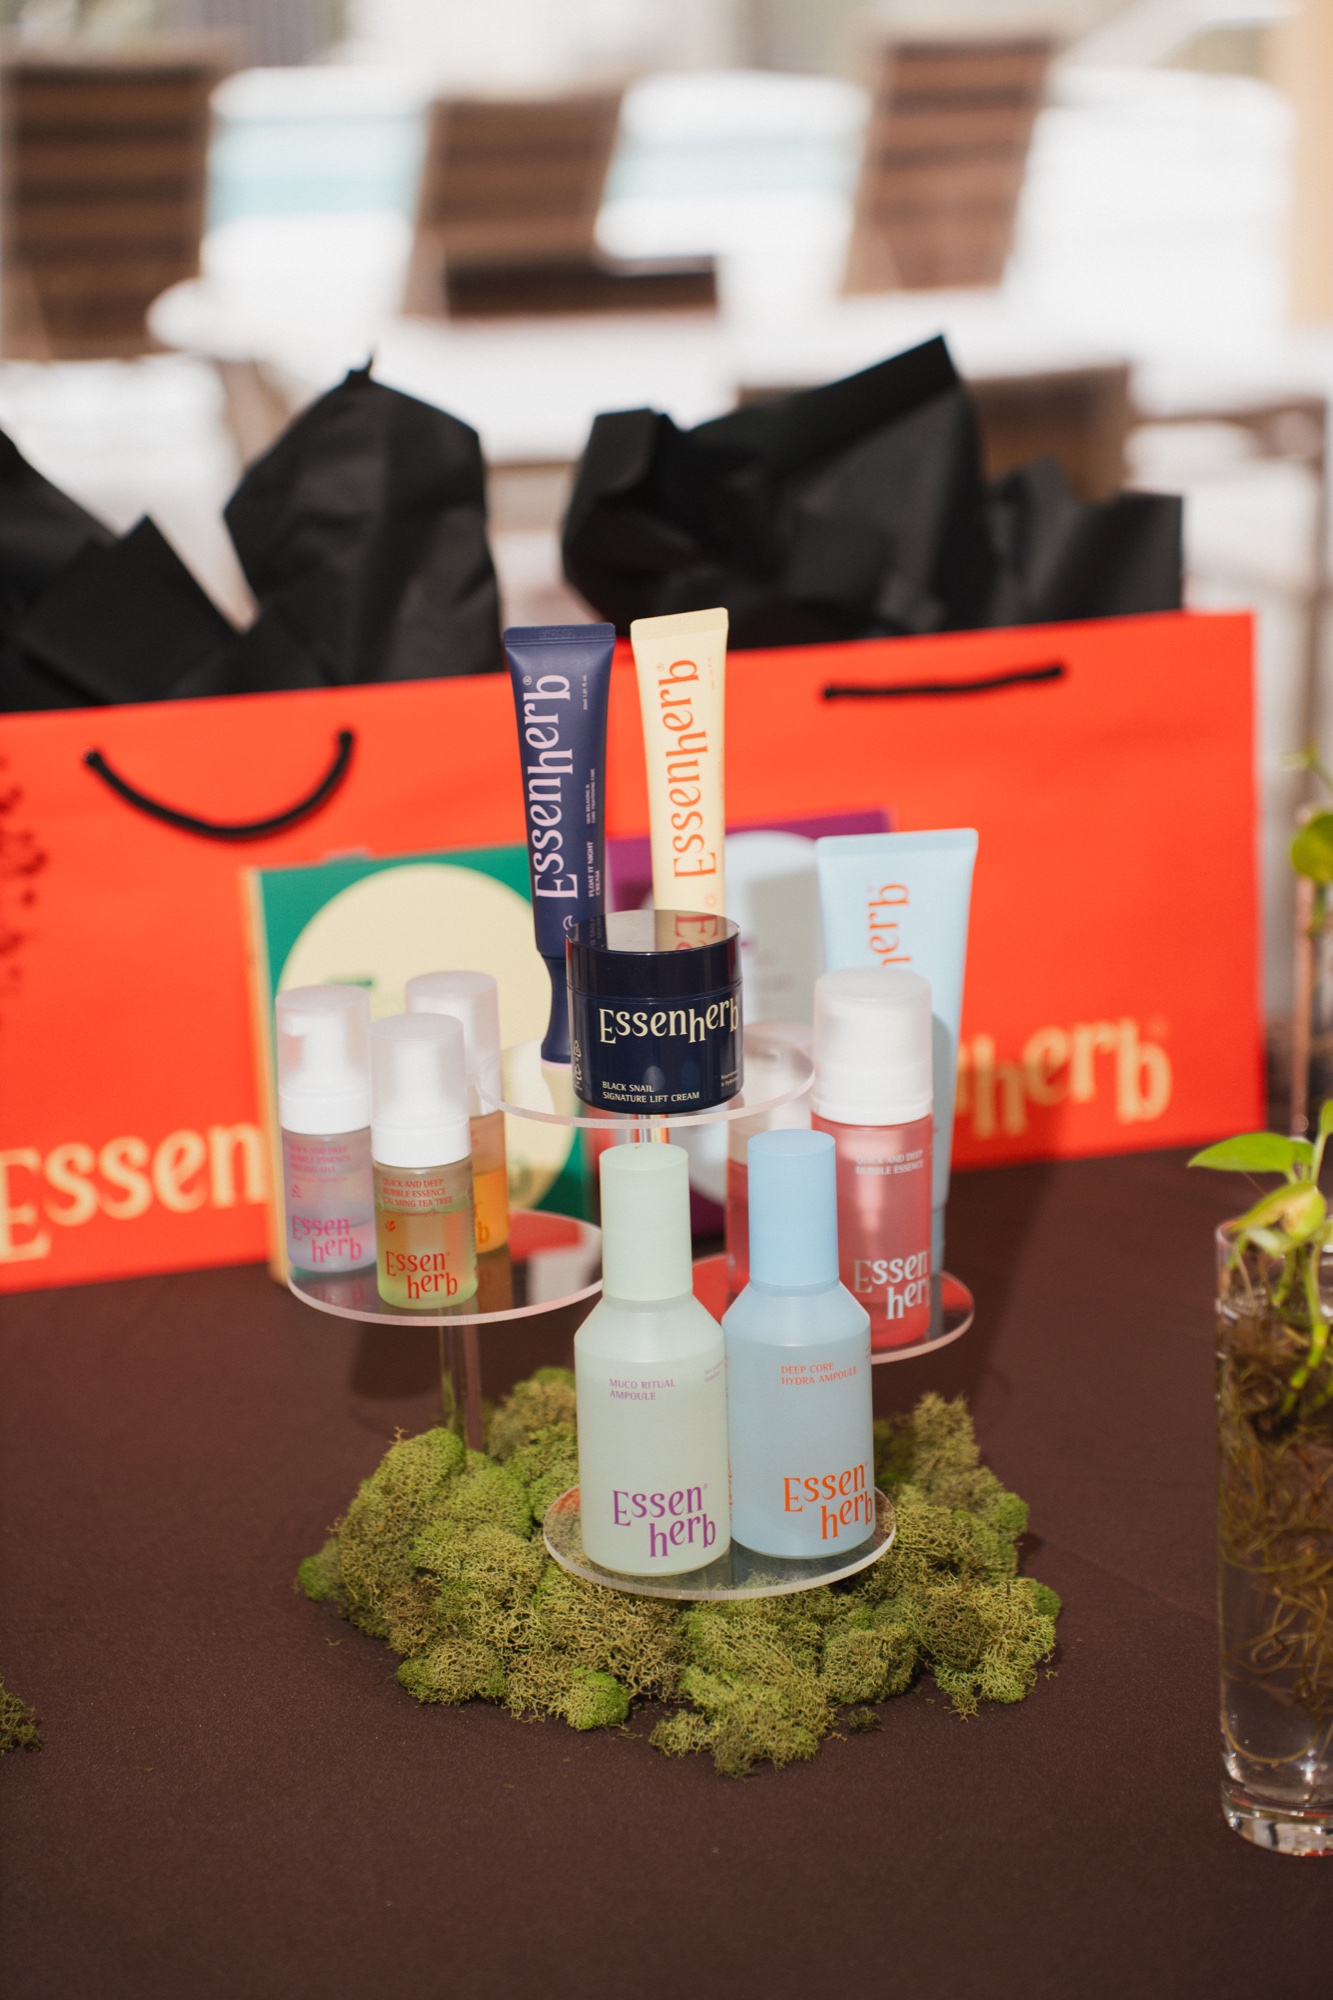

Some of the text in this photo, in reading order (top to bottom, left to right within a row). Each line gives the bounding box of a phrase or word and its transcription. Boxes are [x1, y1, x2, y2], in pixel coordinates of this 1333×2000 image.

[658, 659, 716, 878] Essenherb
[523, 674, 578, 899] Essenherb
[598, 998, 739, 1044] Essenherb
[602, 1081, 655, 1093] BLACK SNAIL
[602, 1091, 700, 1103] SIGNATURE LIFT CREAM
[383, 1178, 445, 1189] QUICK AND DEEP
[383, 1187, 447, 1198] BUBBLE ESSENCE
[384, 1196, 454, 1208] CALMING TEA TREE
[292, 1216, 351, 1241] Essen
[311, 1237, 362, 1263] herb
[386, 1251, 446, 1277] Essen
[854, 1249, 928, 1293] Essen
[407, 1272, 459, 1300] herb
[781, 1362, 834, 1375] DEEP CORE
[781, 1365, 857, 1386] HYDRA AMPOULE
[609, 1378, 676, 1390] MUCO RITUAL
[610, 1389, 657, 1401] AMPOULE
[783, 1463, 865, 1513] Essen
[612, 1486, 704, 1527] Essen
[821, 1492, 873, 1540] herb
[649, 1513, 716, 1557] herb
